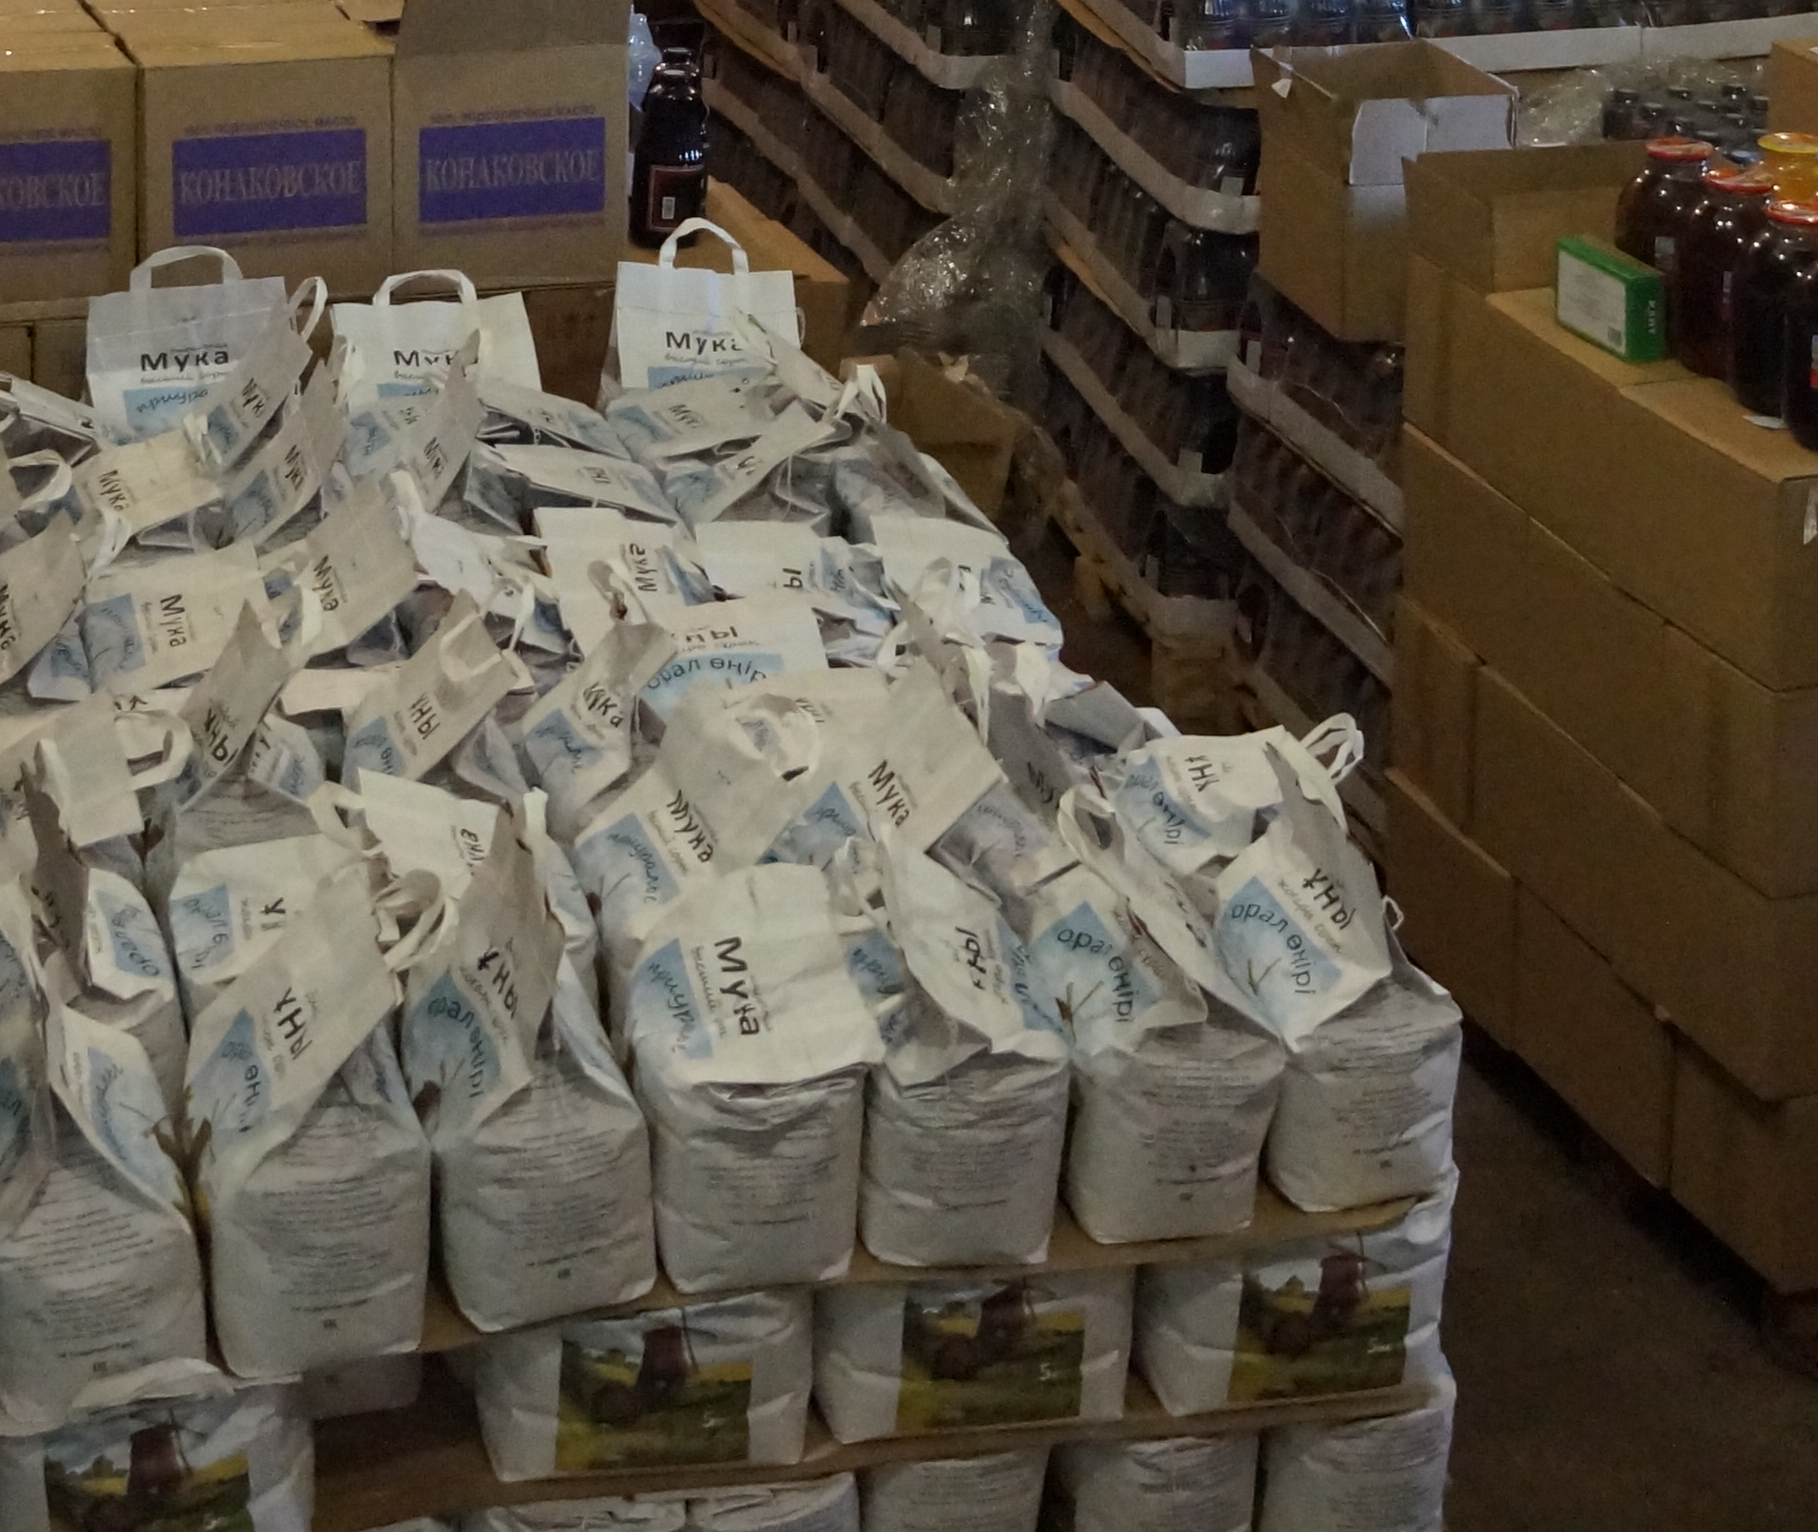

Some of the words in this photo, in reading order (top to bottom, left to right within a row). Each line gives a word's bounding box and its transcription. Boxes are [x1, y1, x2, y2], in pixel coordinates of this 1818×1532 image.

[178, 160, 363, 207] КОНАКОВСКОЕ
[424, 148, 602, 191] КОНАКОВСКОЕ
[140, 350, 230, 372] Мука
[312, 554, 341, 614] Мука
[160, 592, 189, 648] Мука
[709, 656, 769, 686] өңір
[666, 788, 714, 864] Мука
[868, 759, 911, 828] Мука
[1302, 866, 1357, 931] ҰНЫ
[1230, 898, 1289, 933] орал
[1284, 926, 1318, 998] өңірі
[475, 948, 520, 1021] ҰНЫ
[714, 934, 763, 1038] Мука
[1107, 955, 1142, 1026] өңірі
[273, 986, 313, 1062] ҰНЫ
